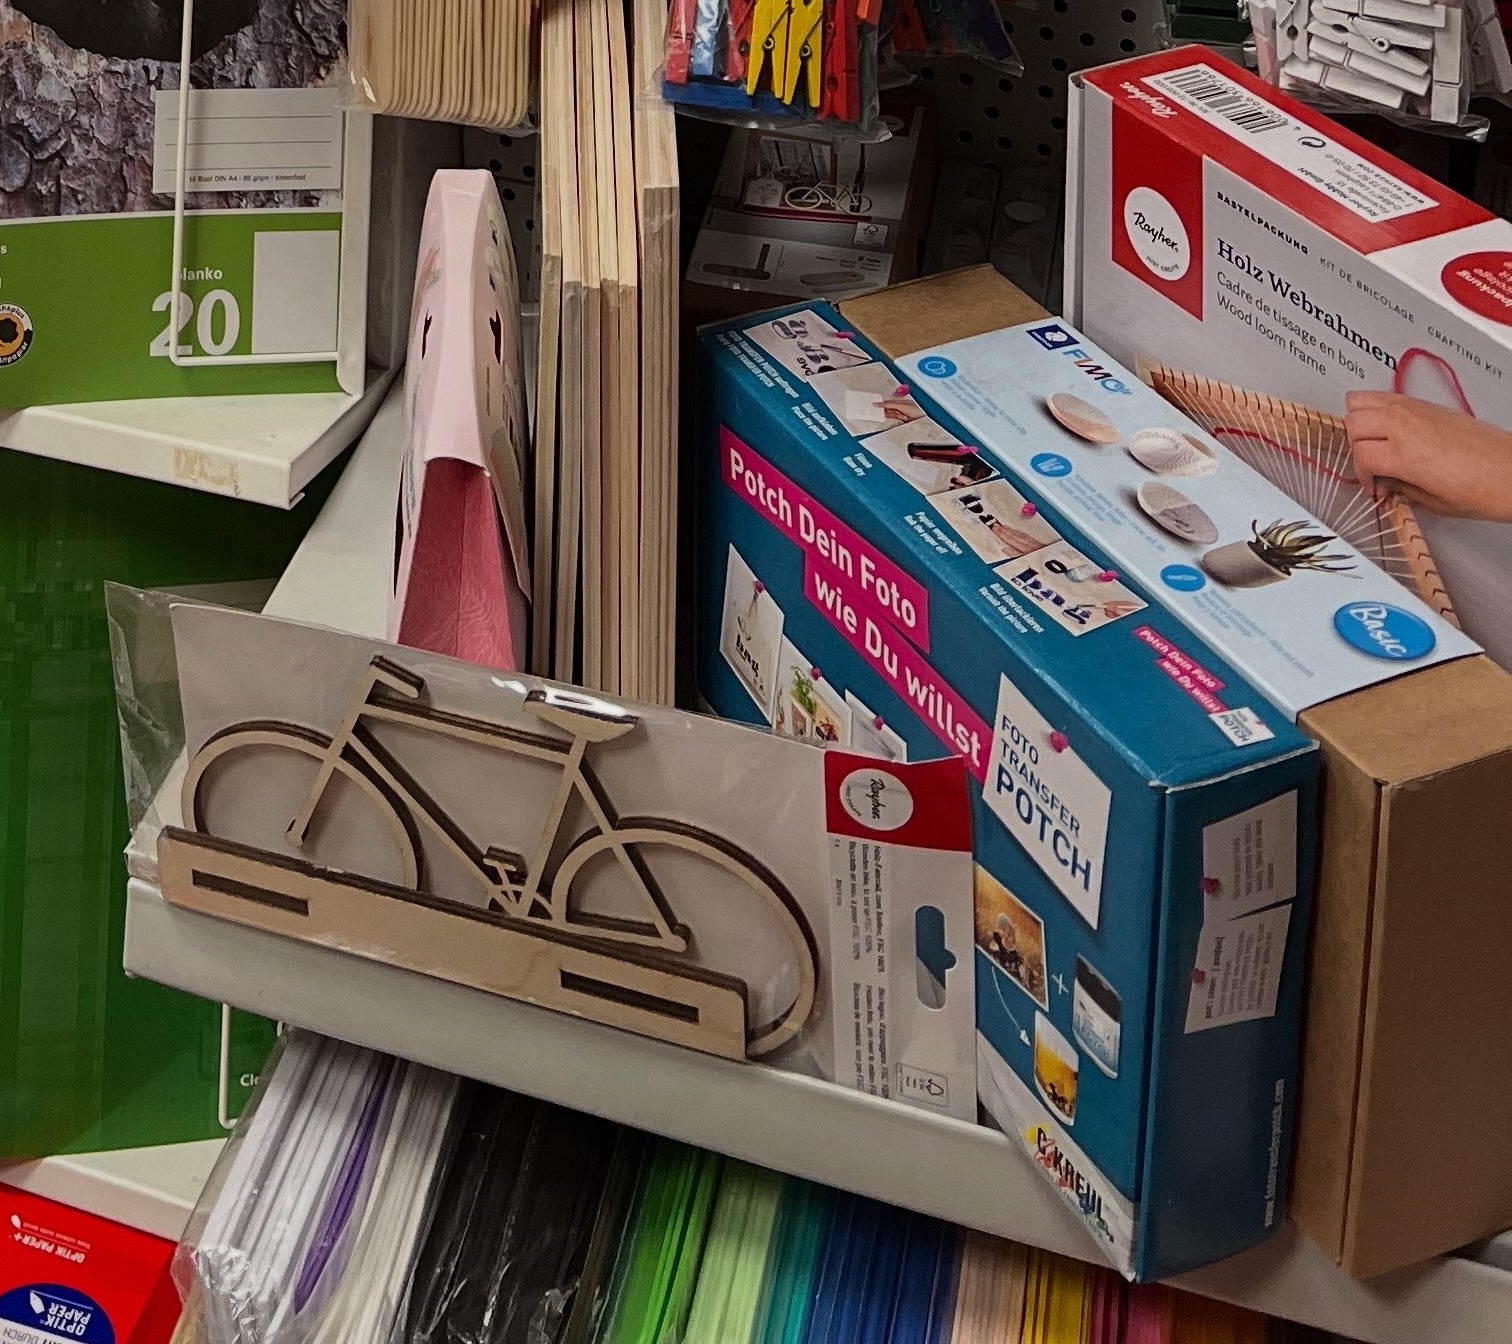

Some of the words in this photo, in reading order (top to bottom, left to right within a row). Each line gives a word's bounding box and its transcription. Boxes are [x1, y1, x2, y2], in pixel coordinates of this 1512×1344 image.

[1217, 192, 1309, 256] BASTELPACKUNG
[149, 289, 241, 357] 20
[1217, 238, 1265, 283] Holz
[1267, 270, 1399, 372] Webrahmen
[1319, 257, 1336, 272] KIT
[1339, 269, 1354, 283] DE
[1356, 280, 1416, 324] BRICOLAGE
[1216, 271, 1253, 306] Cadre
[1255, 293, 1271, 313] de
[1272, 304, 1318, 349] tissage
[1319, 341, 1336, 358] en
[1337, 347, 1366, 379] bois
[1216, 291, 1253, 325] Wood
[1254, 316, 1287, 349] loom
[1288, 338, 1327, 376] frame
[1427, 326, 1482, 366] CRAFTING
[729, 447, 793, 529] Potch
[799, 500, 854, 579] Dein
[860, 558, 917, 630] Foto
[1138, 628, 1170, 656] Potch
[1192, 665, 1217, 689] Foto
[1349, 604, 1409, 659] Basic
[814, 572, 859, 635] wie
[864, 624, 900, 684] Du
[902, 667, 983, 769] willst
[1192, 686, 1221, 713] willst
[1001, 714, 1039, 766] FOTO
[1218, 713, 1251, 743] POTCH
[1000, 738, 1081, 838] TRANSFER
[996, 764, 1092, 892] POTCH
[44, 1313, 86, 1337] OPTIK
[48, 1301, 92, 1326] PAPER
